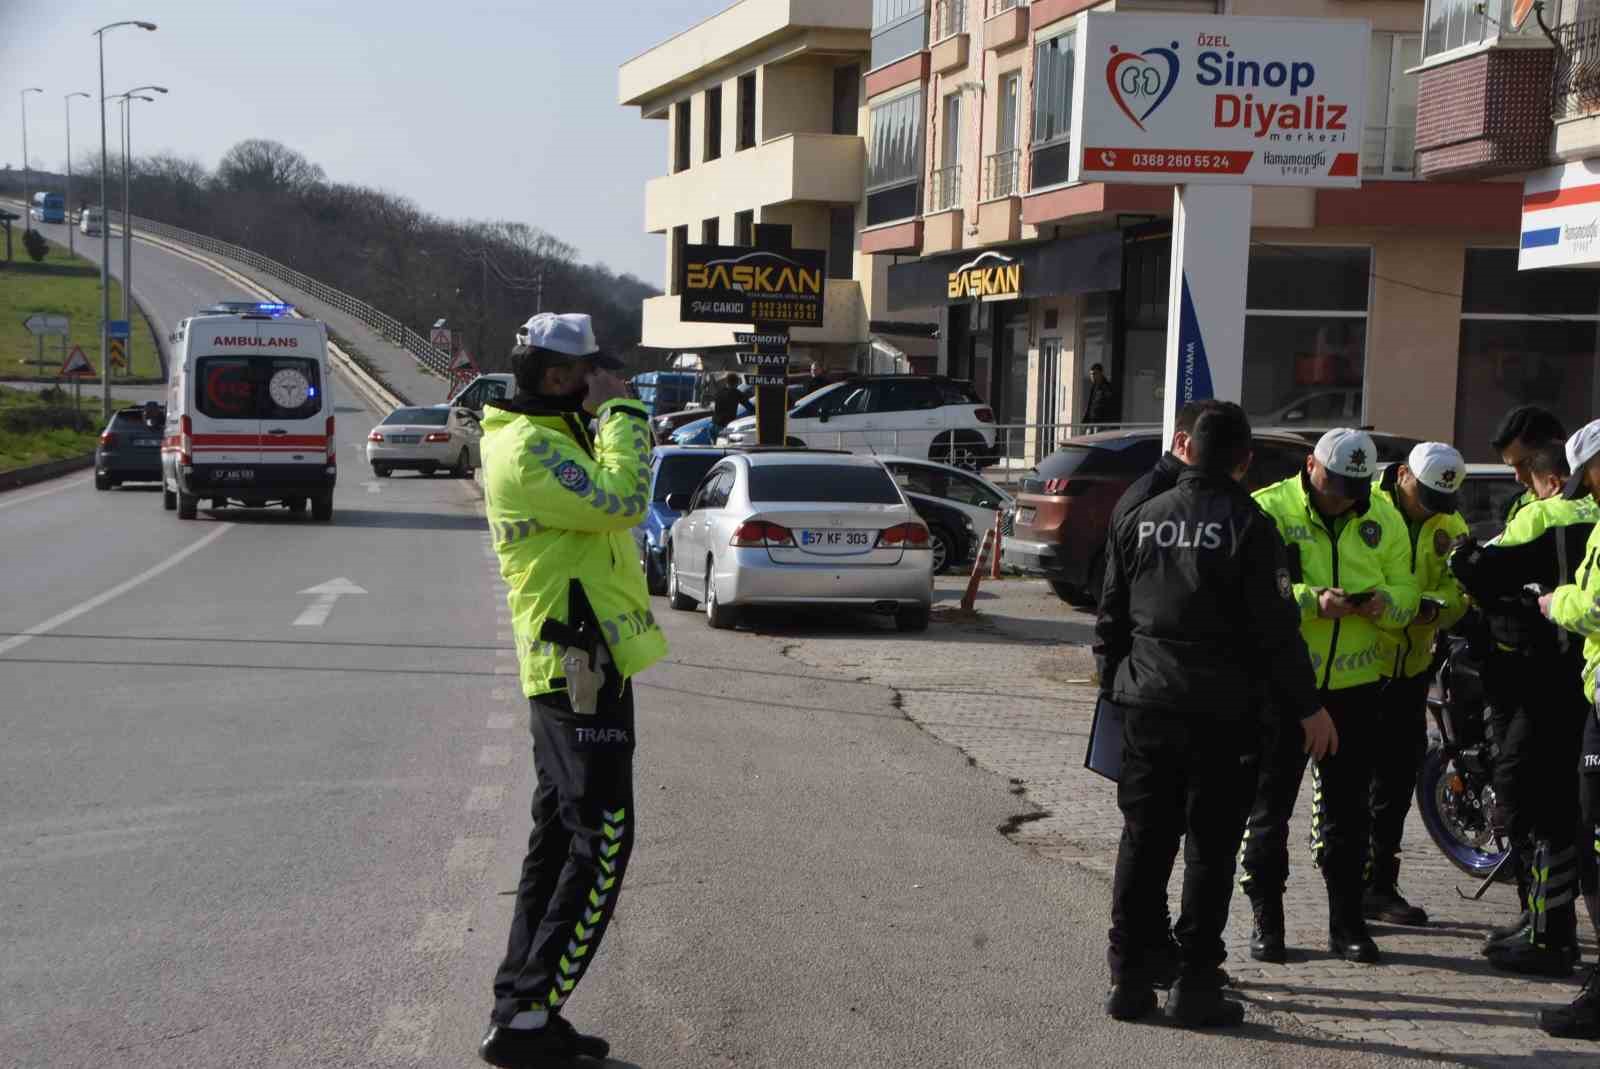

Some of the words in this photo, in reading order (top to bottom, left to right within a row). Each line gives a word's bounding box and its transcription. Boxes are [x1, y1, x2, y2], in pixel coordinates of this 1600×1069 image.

[1197, 32, 1230, 48] ÖZEL
[1196, 50, 1315, 96] Sinop
[1214, 93, 1348, 138] Diyaliz
[1269, 131, 1346, 143] merkezi
[1132, 153, 1165, 167] 0368
[1167, 154, 1192, 168] 260
[1194, 155, 1211, 168] 55
[1213, 156, 1230, 169] 24
[213, 335, 298, 348] AMBULANS
[748, 376, 785, 385] EMLAK
[808, 534, 823, 545] 57
[827, 533, 843, 545] KF
[846, 533, 868, 545] 303
